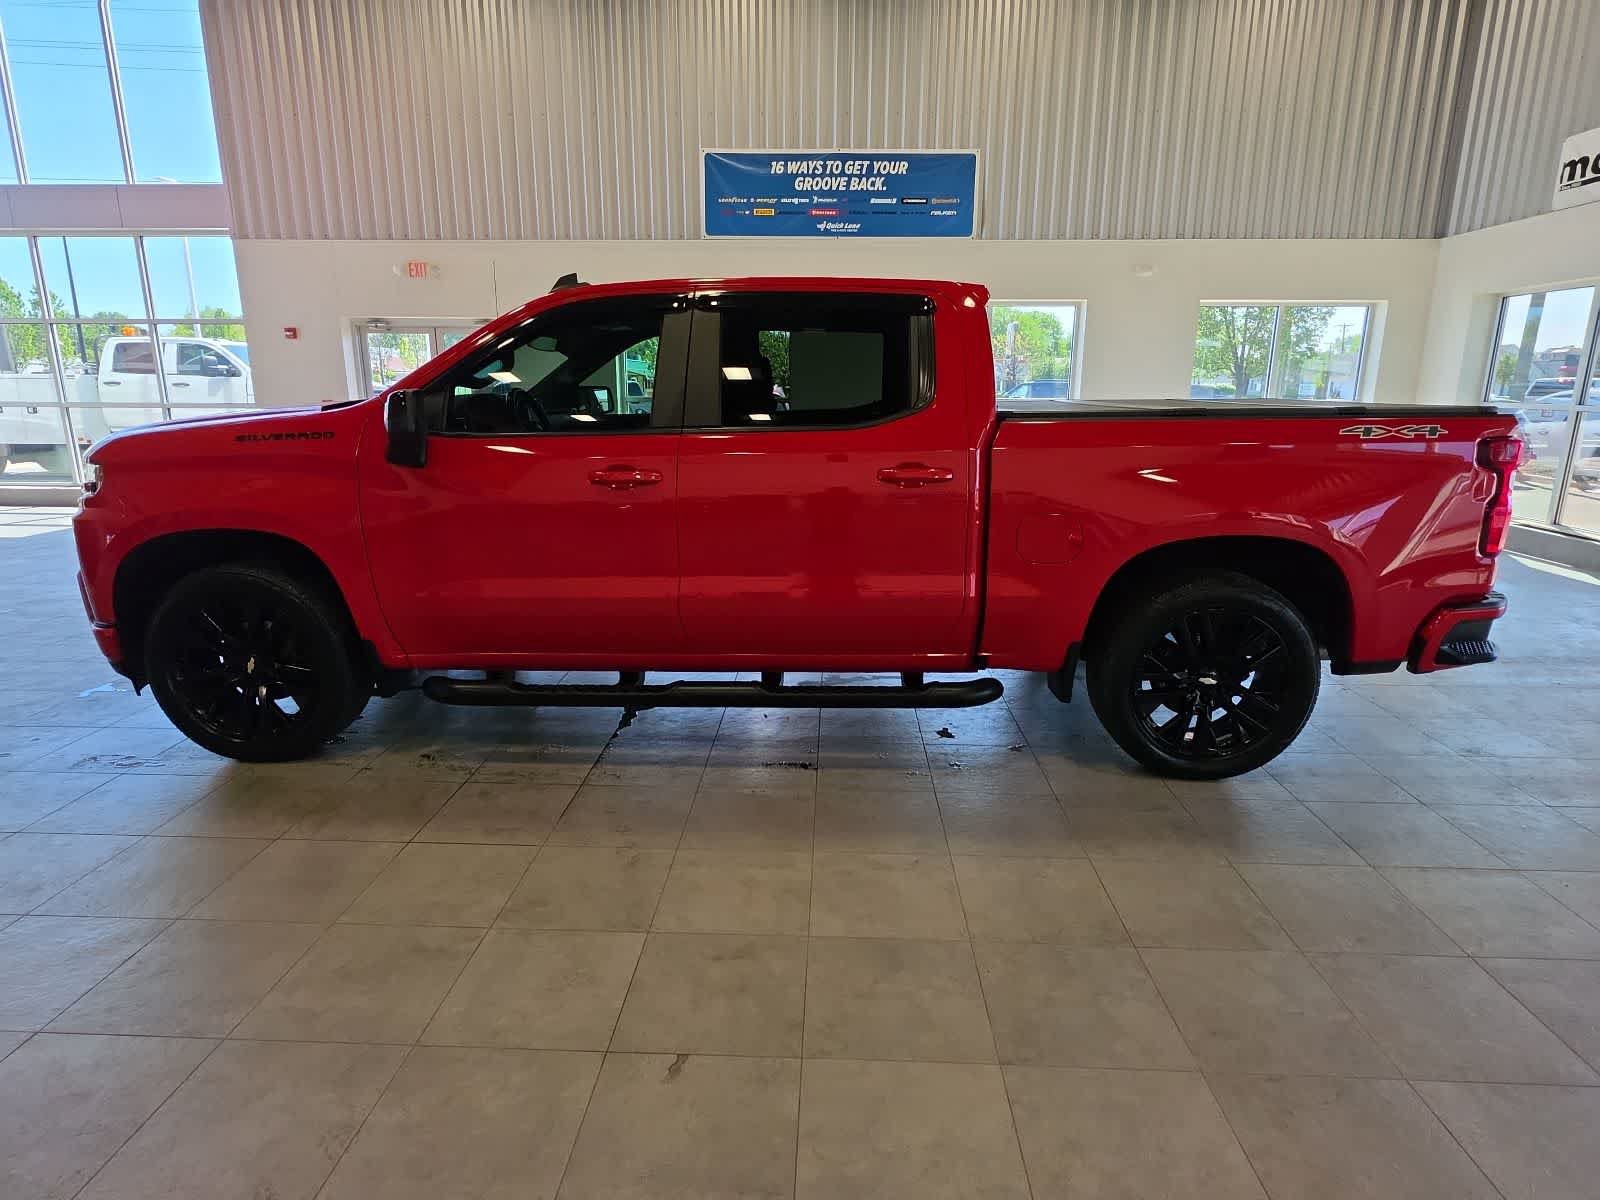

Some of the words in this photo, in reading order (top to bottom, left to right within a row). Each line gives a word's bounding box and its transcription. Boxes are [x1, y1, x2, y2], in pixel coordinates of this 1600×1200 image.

[770, 161, 785, 174] 16
[787, 161, 823, 174] WAYS
[825, 160, 843, 174] TO
[844, 160, 870, 174] GET
[873, 161, 909, 174] YOUR
[794, 177, 848, 191] GROOVE
[849, 177, 887, 191] BACK.
[408, 262, 428, 278] EXIT
[235, 431, 335, 442] SILVERADO
